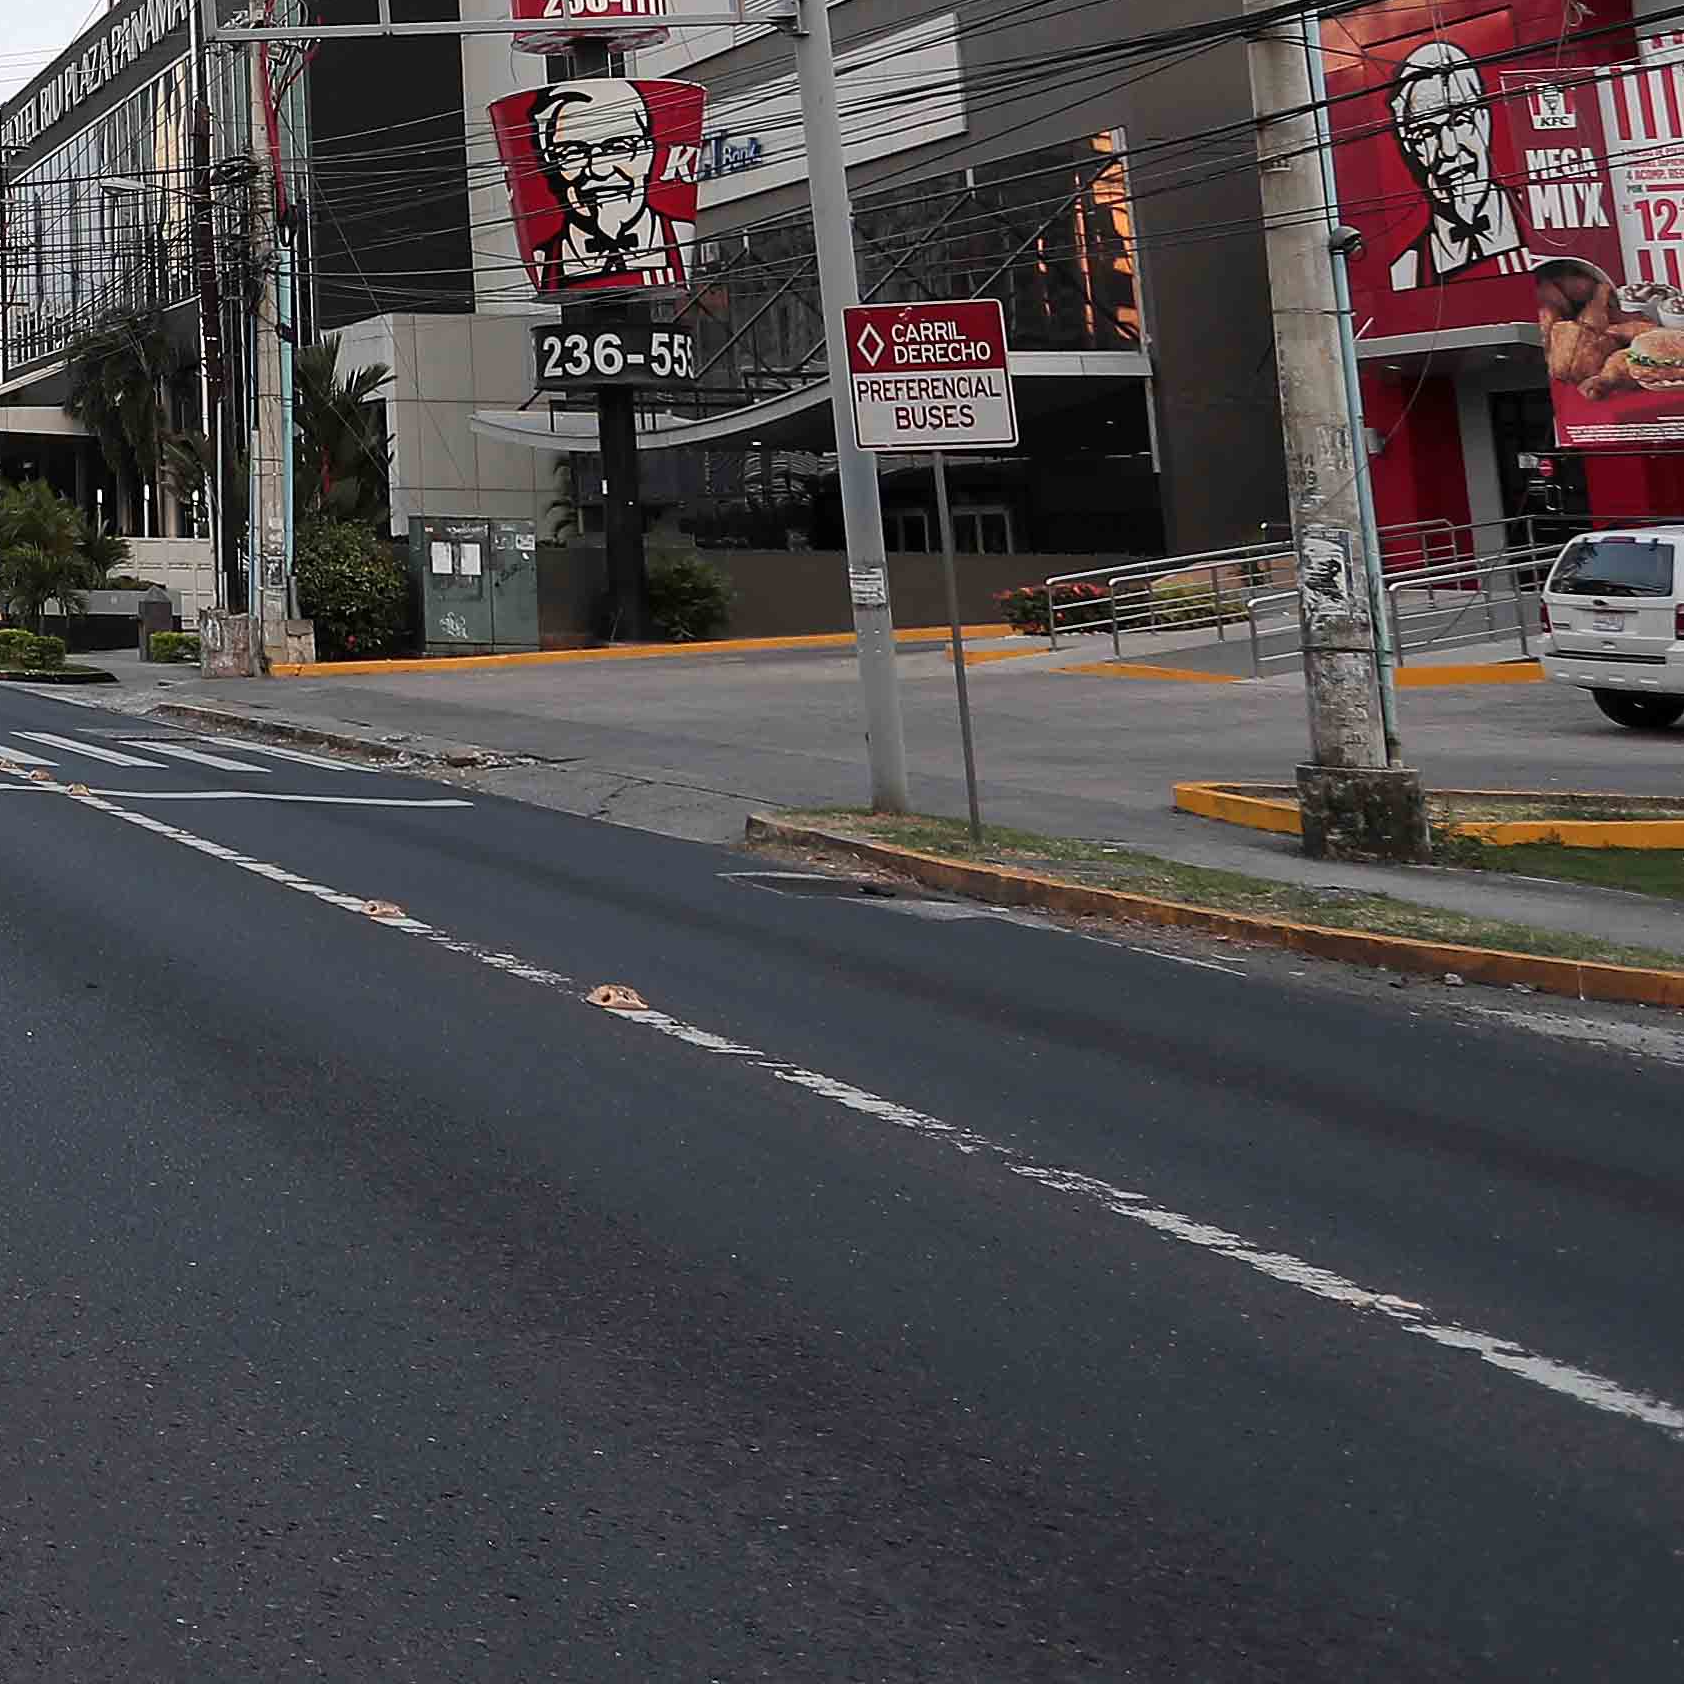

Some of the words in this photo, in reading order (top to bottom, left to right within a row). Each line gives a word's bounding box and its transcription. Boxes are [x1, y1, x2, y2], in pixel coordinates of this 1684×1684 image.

[40, 74, 64, 131] RIU
[65, 36, 113, 113] PLAZA
[1540, 117, 1569, 127] KFC
[1525, 148, 1599, 181] MEGA
[1528, 183, 1610, 229] MIX
[1633, 198, 1682, 241] 12
[891, 321, 967, 343] CARRIL
[893, 341, 991, 364] DERECHO
[856, 376, 1002, 403] PREFERENCIAL
[895, 404, 975, 430] BUSES
